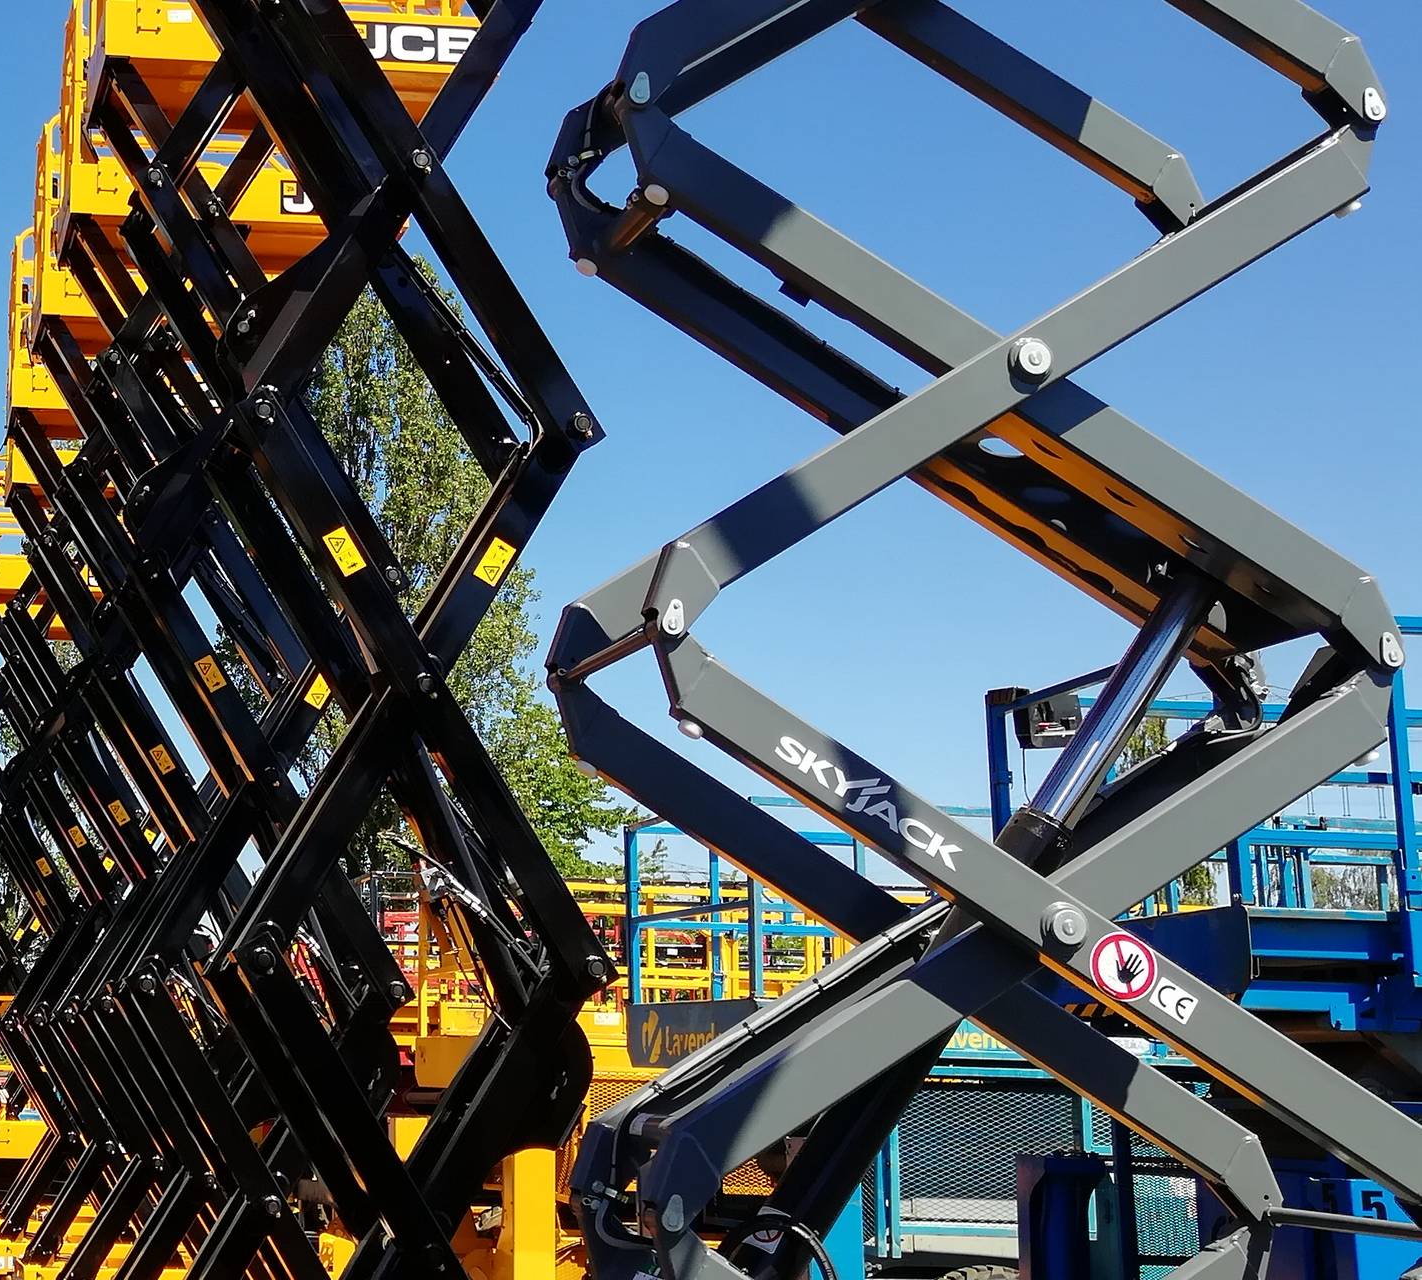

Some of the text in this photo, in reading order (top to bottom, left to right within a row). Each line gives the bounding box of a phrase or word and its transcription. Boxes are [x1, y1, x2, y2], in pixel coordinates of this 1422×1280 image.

[774, 735, 963, 872] SKYJACK
[1157, 984, 1194, 1020] CE
[665, 1022, 723, 1057] Lavend
